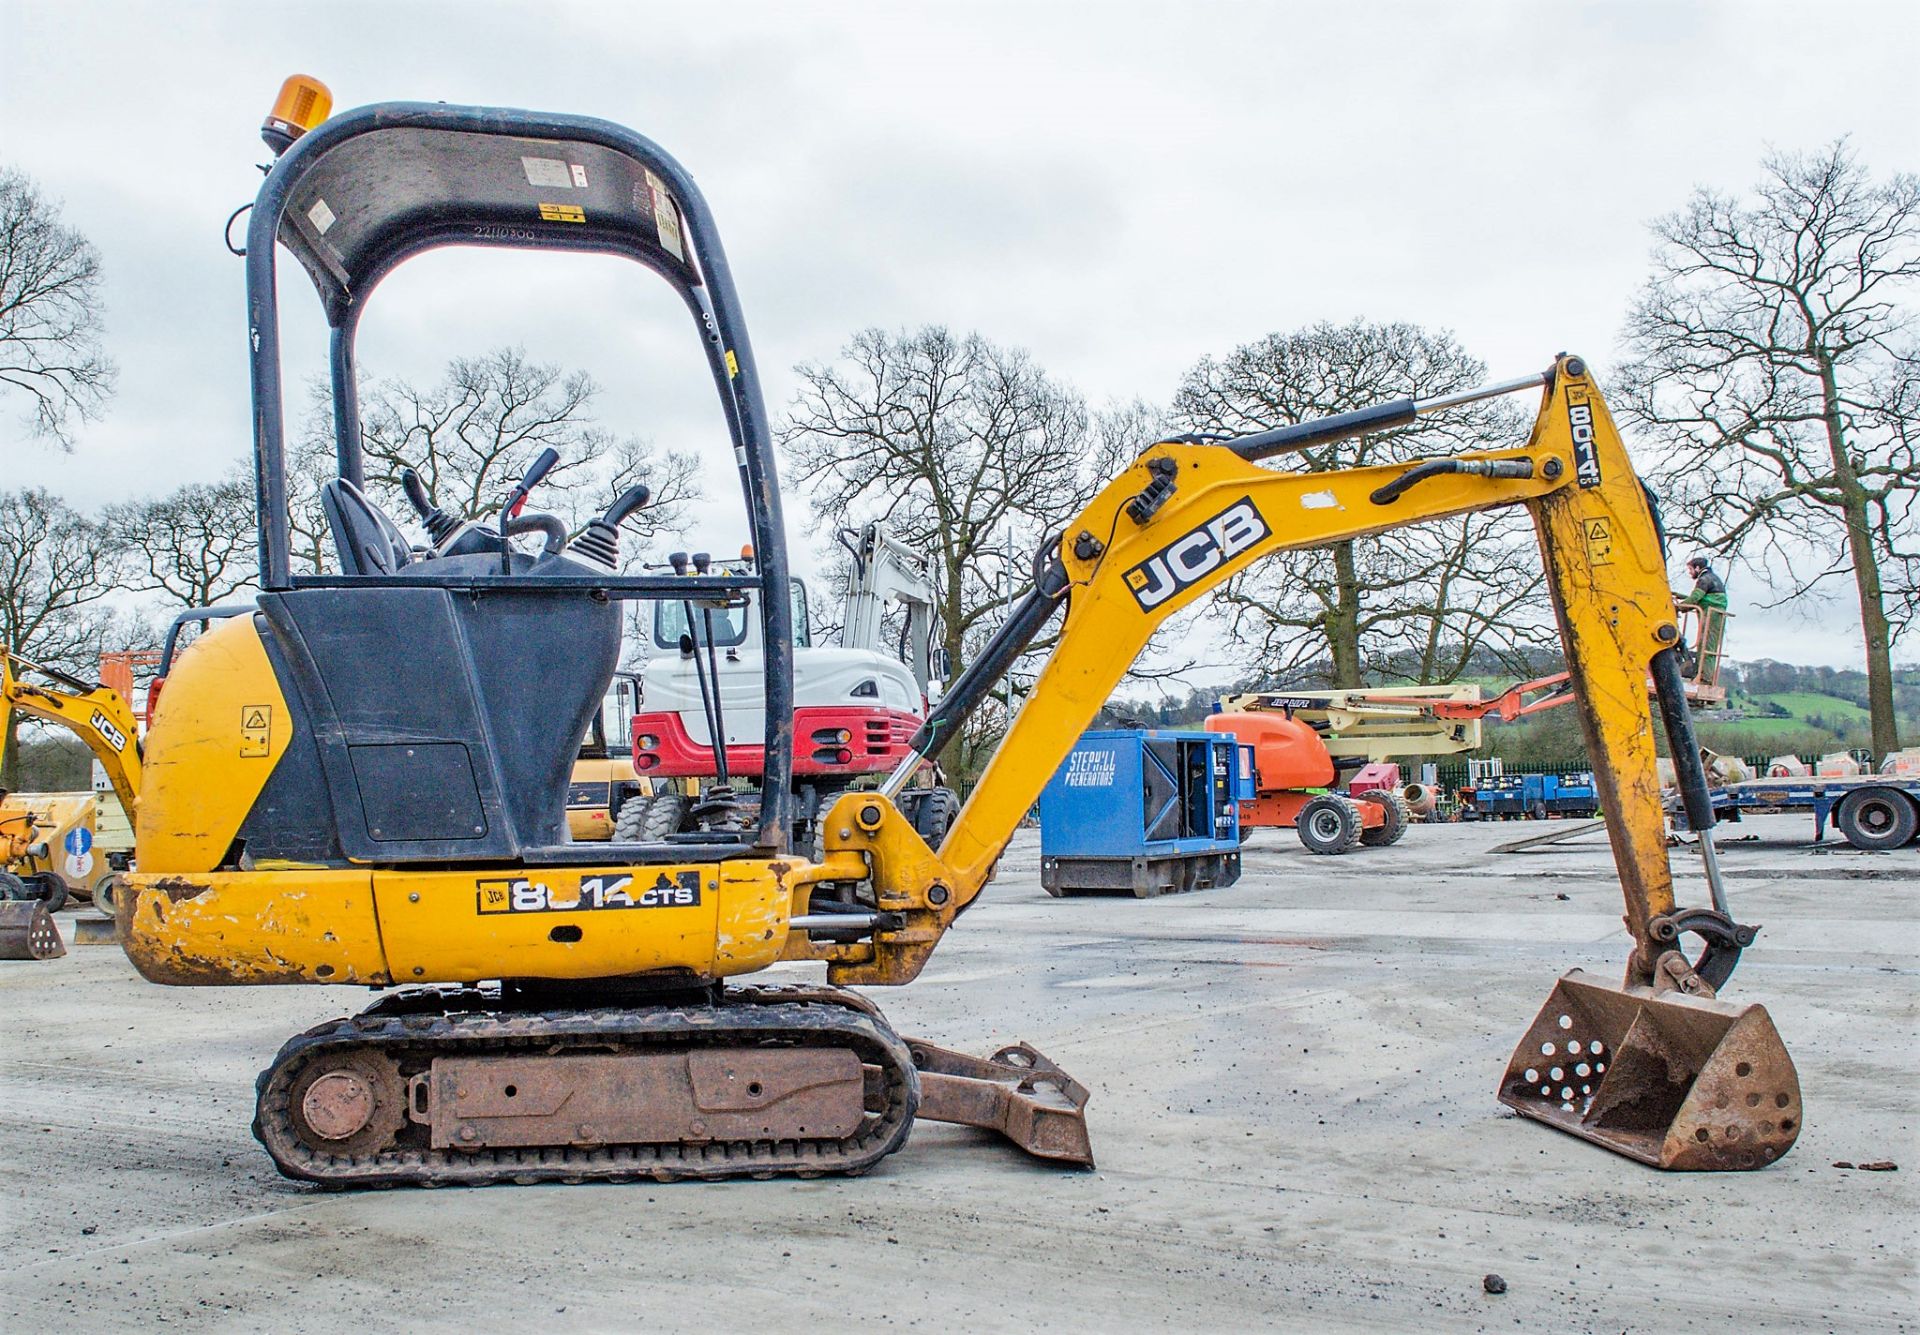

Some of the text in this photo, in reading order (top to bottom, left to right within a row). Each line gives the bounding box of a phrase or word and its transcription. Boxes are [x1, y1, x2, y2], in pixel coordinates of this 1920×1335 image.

[1569, 406, 1599, 477] 8014
[1137, 504, 1265, 607] JCB
[1288, 699, 1310, 708] LIFT
[91, 714, 126, 751] JCB
[1069, 750, 1116, 772] STEPHILL
[1069, 771, 1115, 787] GENERATORS
[639, 887, 693, 905] CTS
